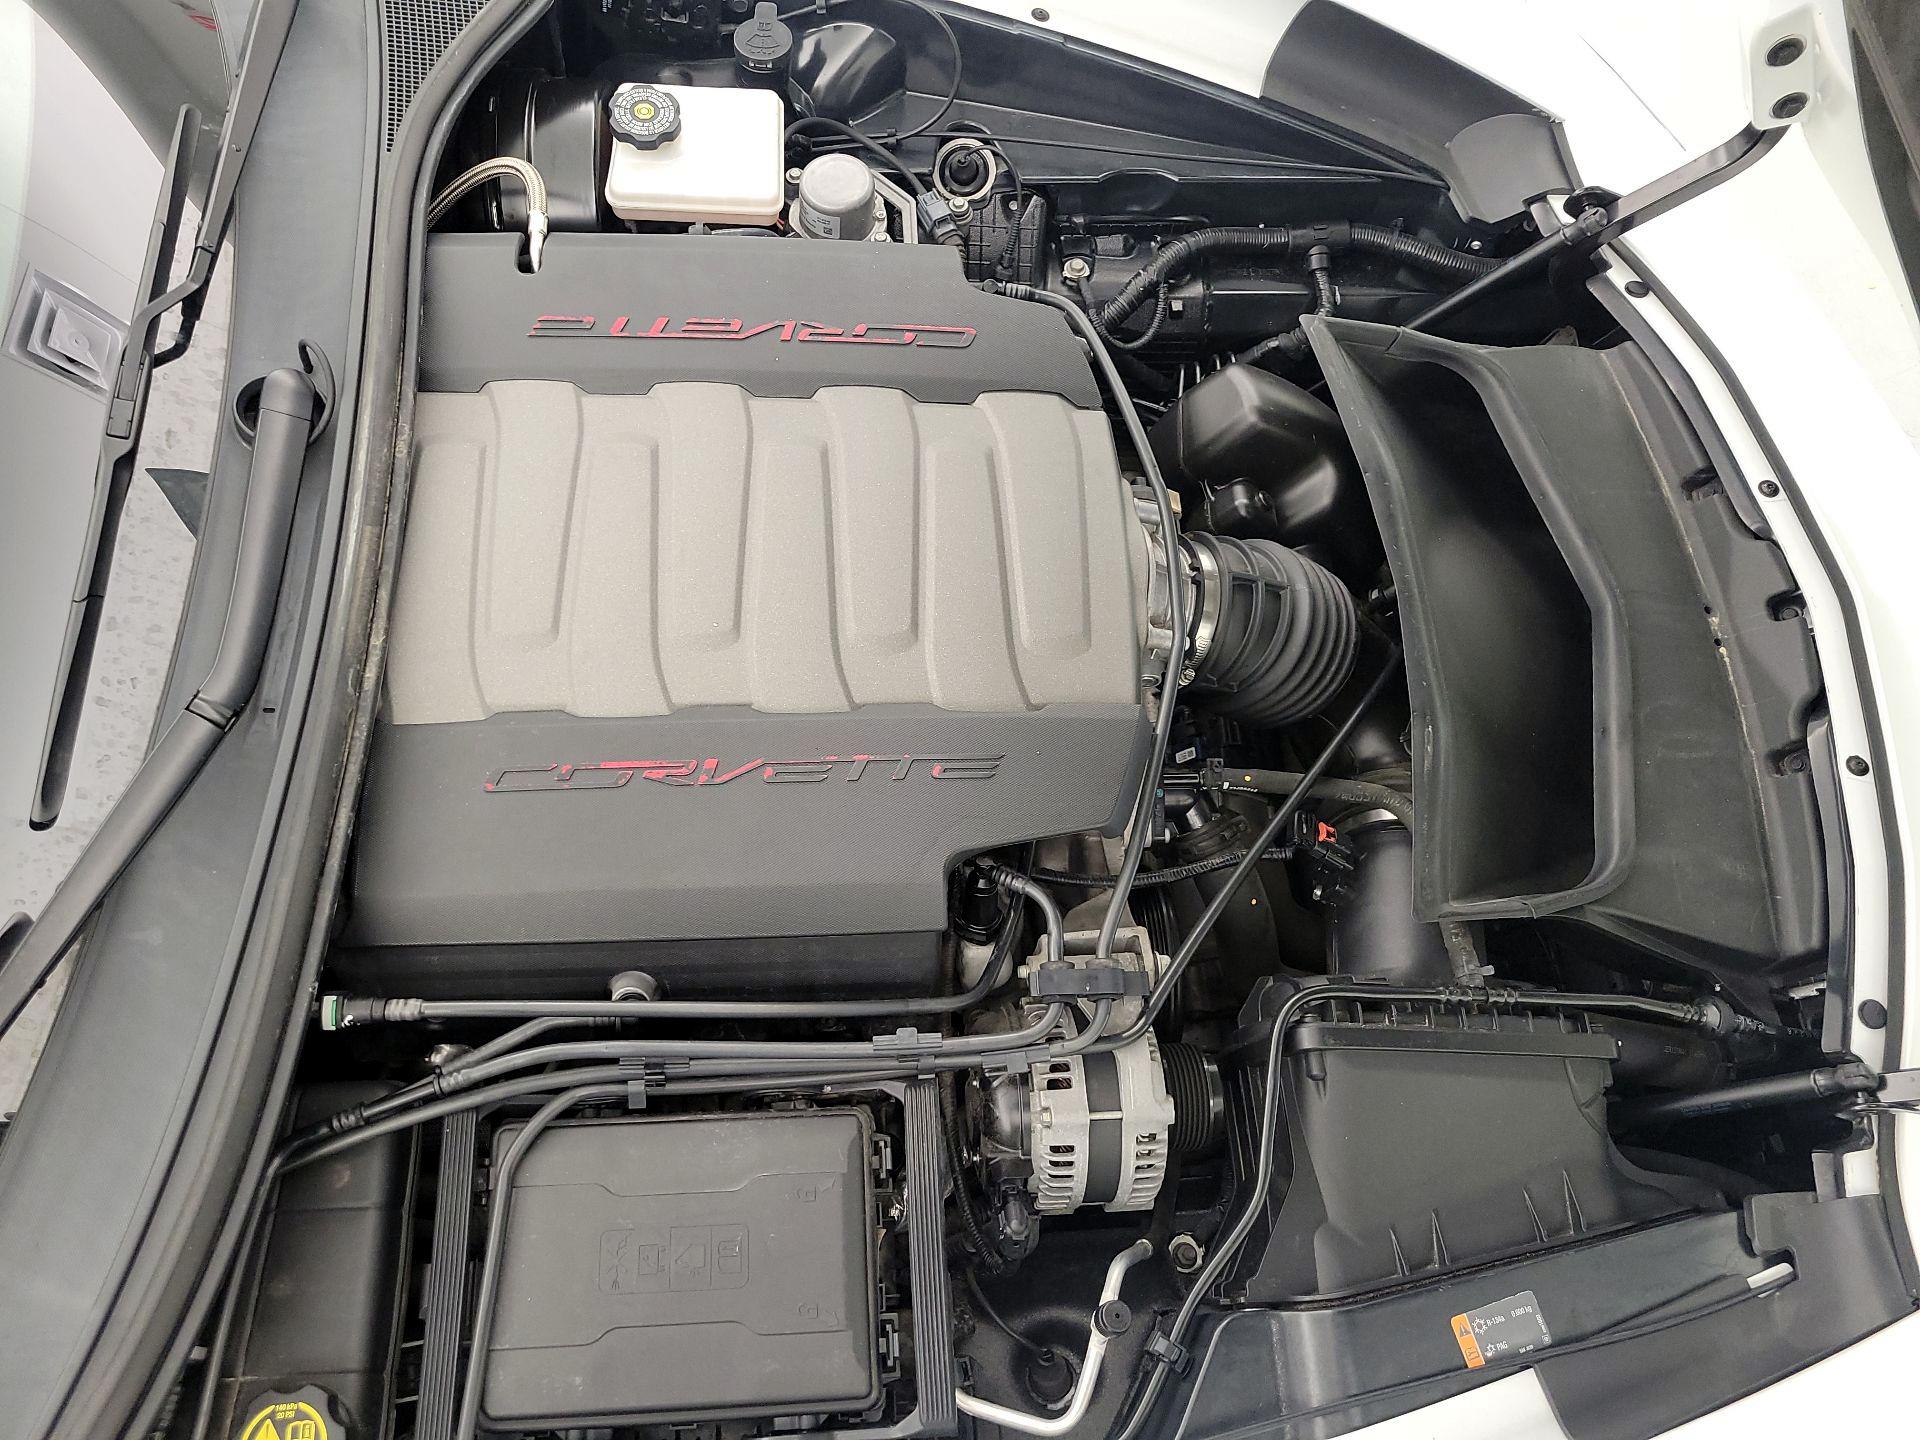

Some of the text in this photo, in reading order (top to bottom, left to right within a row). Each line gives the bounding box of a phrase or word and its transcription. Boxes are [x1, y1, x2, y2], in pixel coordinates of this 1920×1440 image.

[526, 316, 978, 348] CORVETTE
[483, 752, 1006, 793] CORVETTE
[1496, 1340, 1508, 1350] PAG
